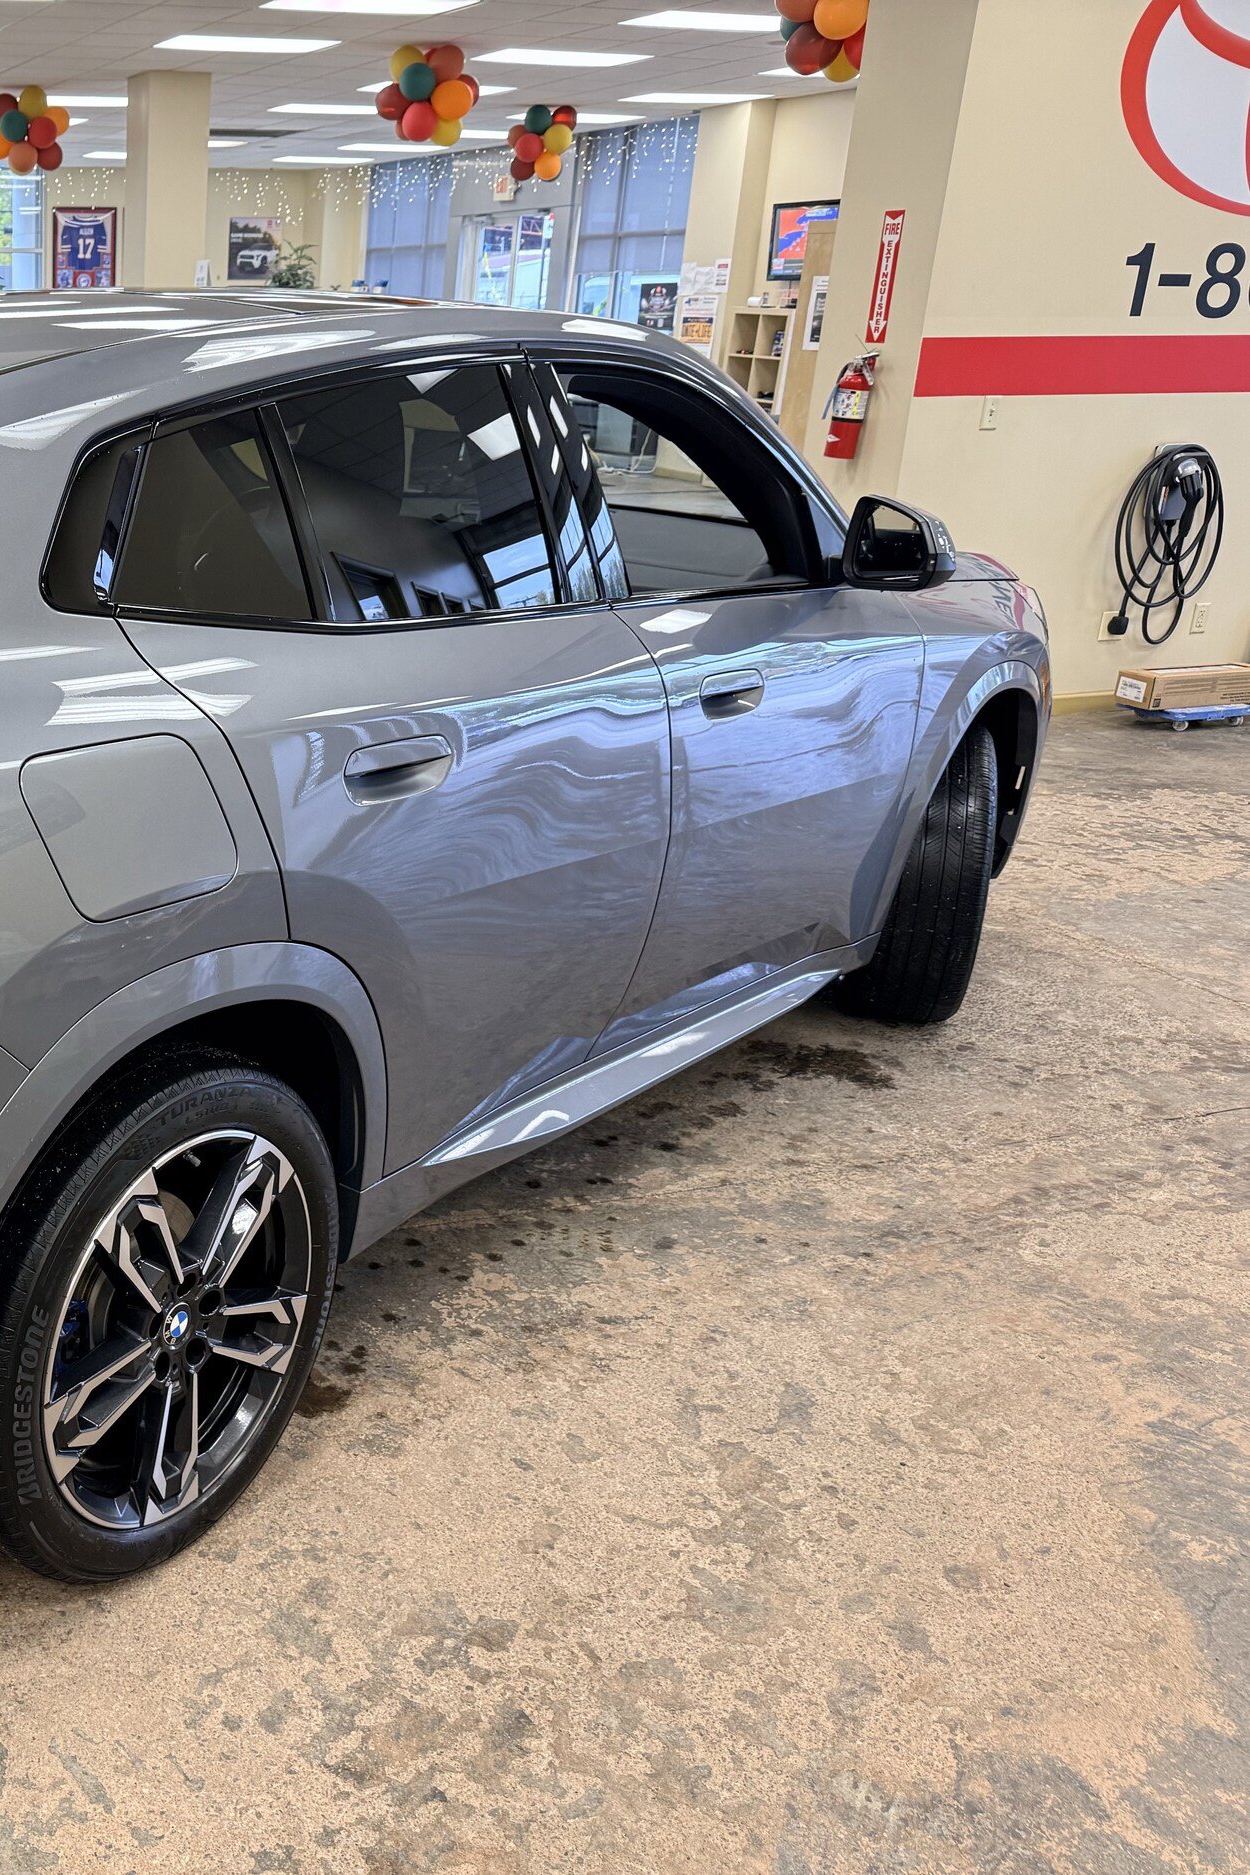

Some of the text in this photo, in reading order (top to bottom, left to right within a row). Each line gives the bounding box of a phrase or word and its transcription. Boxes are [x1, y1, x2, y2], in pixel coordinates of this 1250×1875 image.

[77, 238, 95, 259] 17
[884, 222, 900, 236] FIRE
[873, 240, 893, 334] EXTINGUISHER
[1125, 242, 1250, 319] 1-8
[156, 1085, 251, 1127] TURANZA
[12, 1304, 50, 1506] BRIDGESTONE
